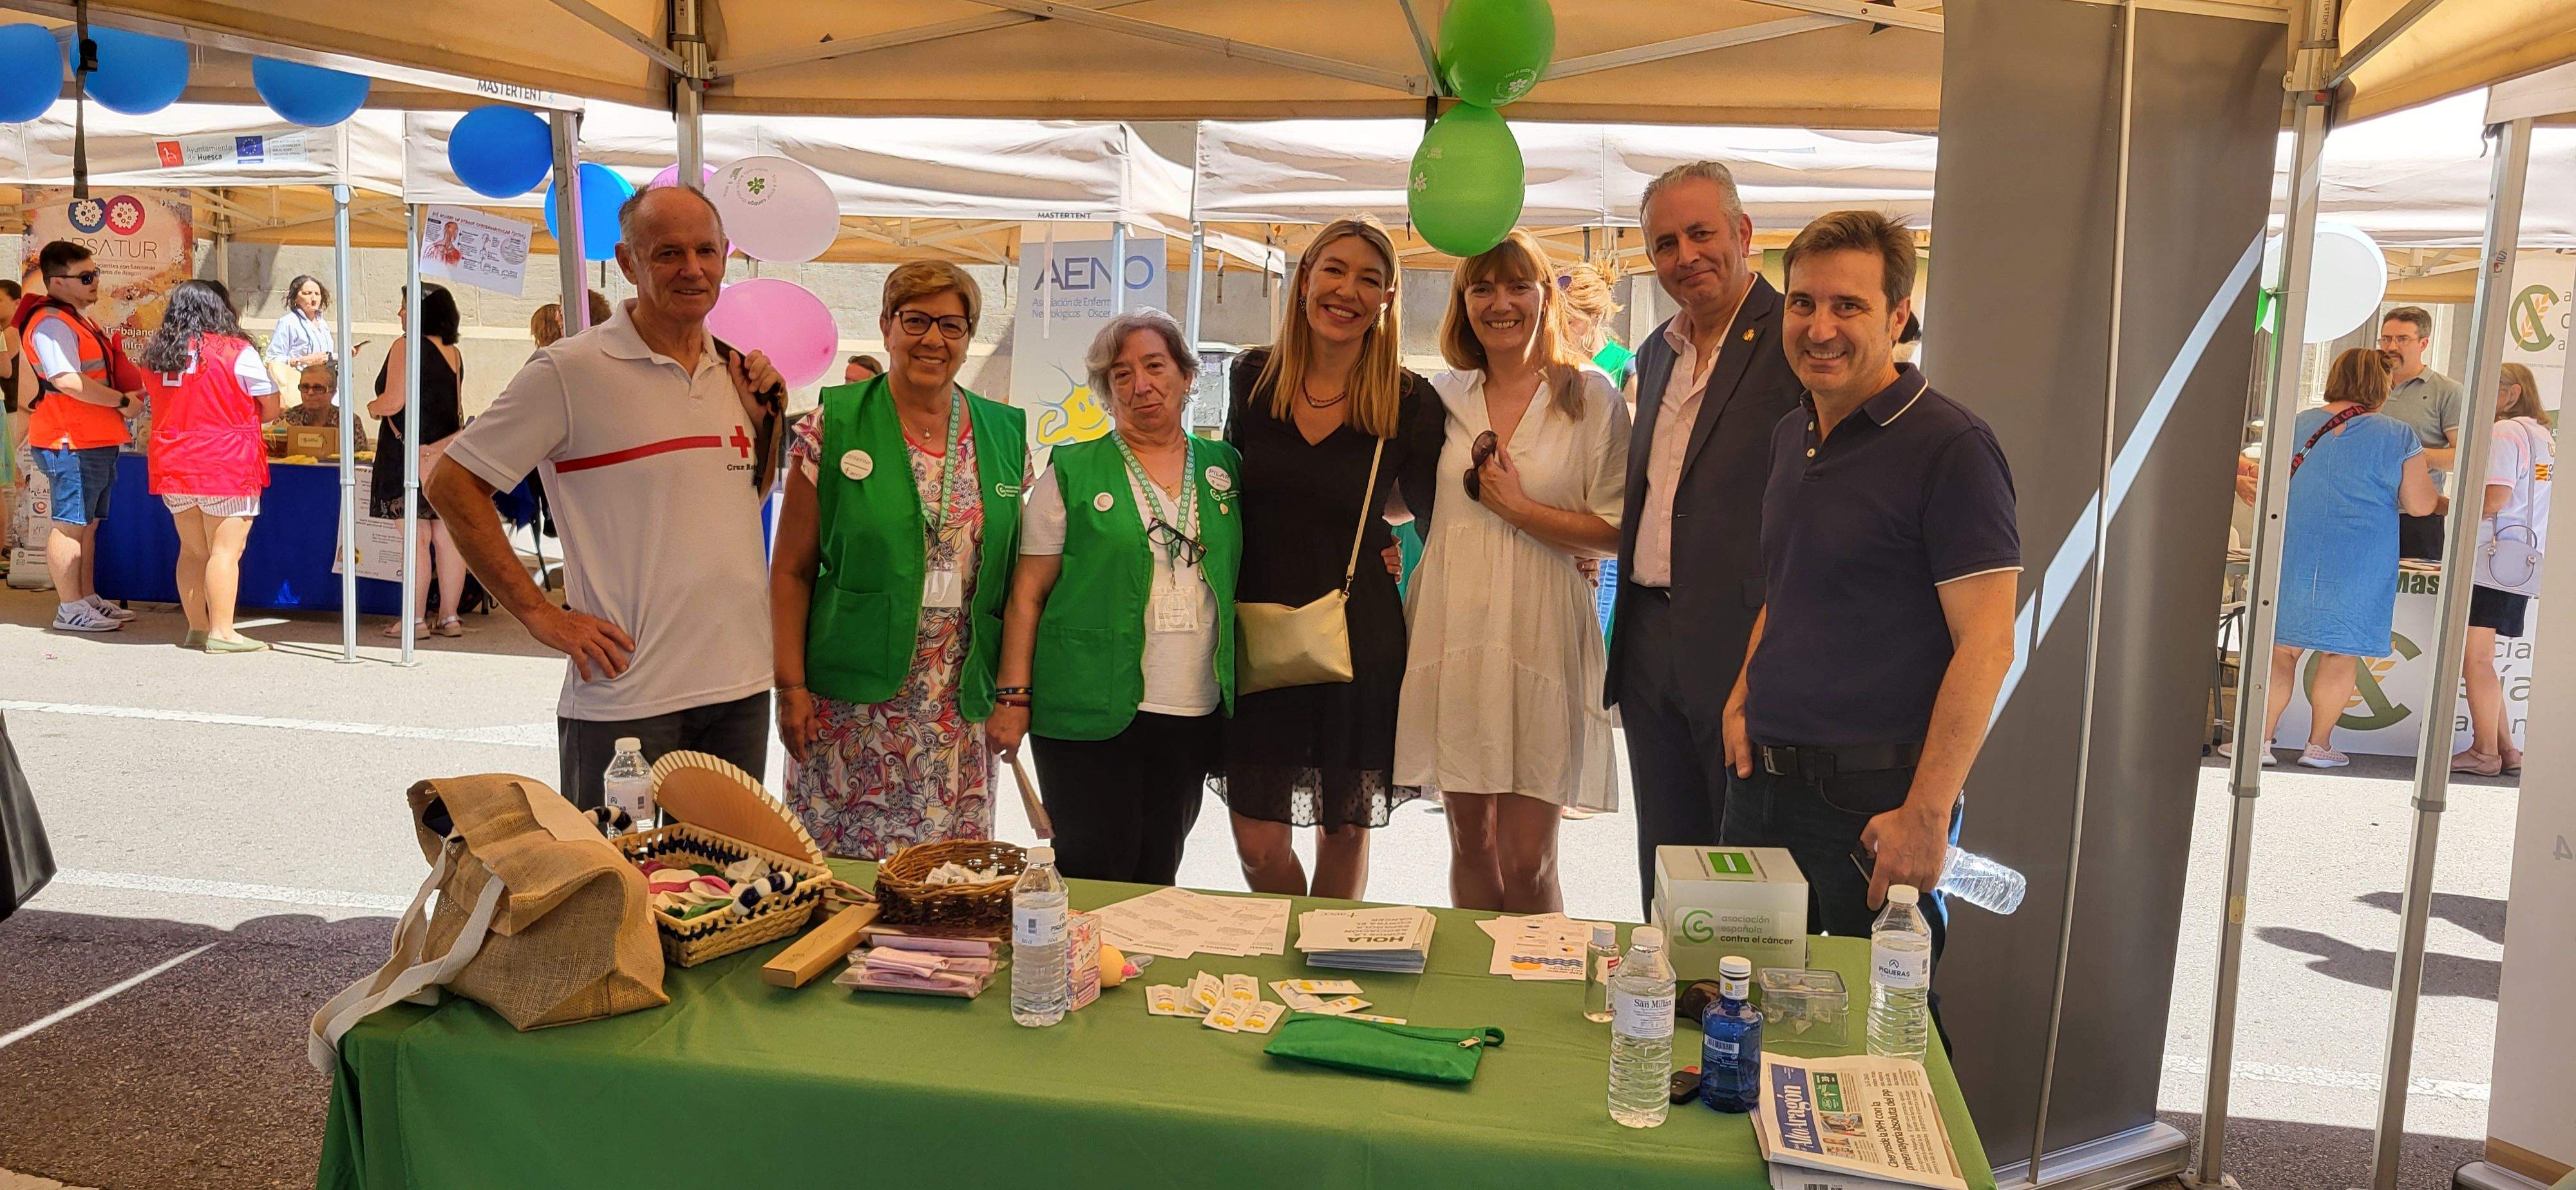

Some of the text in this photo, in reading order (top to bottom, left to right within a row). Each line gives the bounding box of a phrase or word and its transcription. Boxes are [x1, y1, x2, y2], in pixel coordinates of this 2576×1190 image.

[477, 79, 541, 101] MASTERTENT
[186, 145, 232, 154] Ayuntamiento
[1074, 298, 1083, 307] de
[1721, 914, 1770, 923] asociación
[1721, 925, 1762, 934] española
[1720, 934, 1750, 943] contra
[1761, 936, 1794, 945] cáncer
[1879, 966, 1910, 977] PIQUERAS
[1634, 999, 1672, 1008] San Millán
[1884, 1097, 1895, 1106] del
[1875, 1107, 1884, 1119] con
[1888, 1106, 1900, 1130] absoluta
[1874, 1119, 1887, 1131] DPH
[1892, 1131, 1908, 1151] mayoría
[1901, 1152, 1917, 1170] primera
